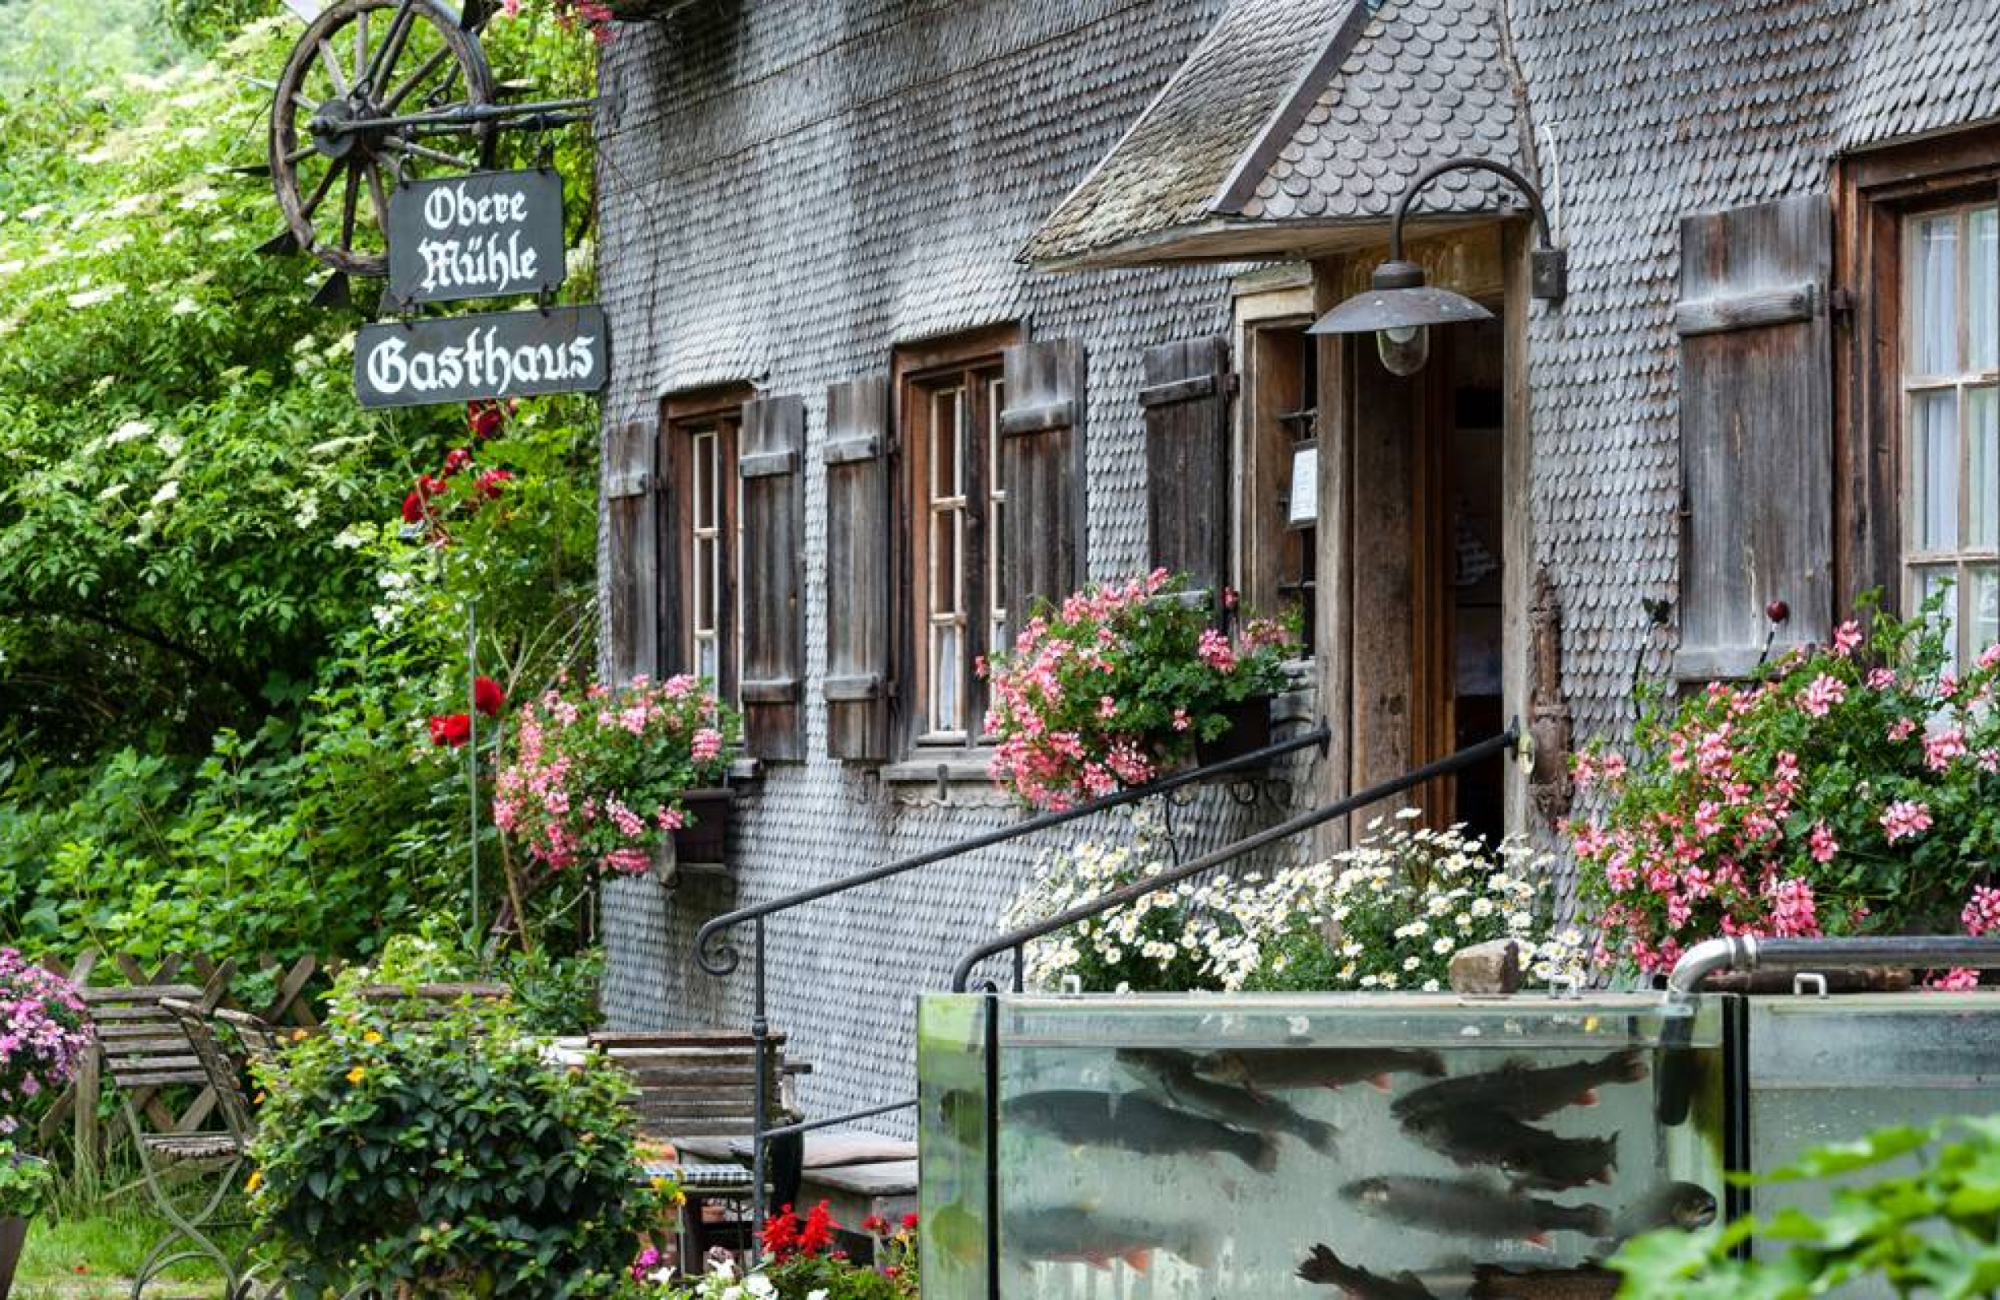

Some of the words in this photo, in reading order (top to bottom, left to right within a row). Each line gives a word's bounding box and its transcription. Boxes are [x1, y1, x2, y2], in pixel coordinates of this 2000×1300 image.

[424, 181, 528, 229] Obere
[417, 230, 538, 293] Mühle
[367, 325, 595, 395] Gasthaus
